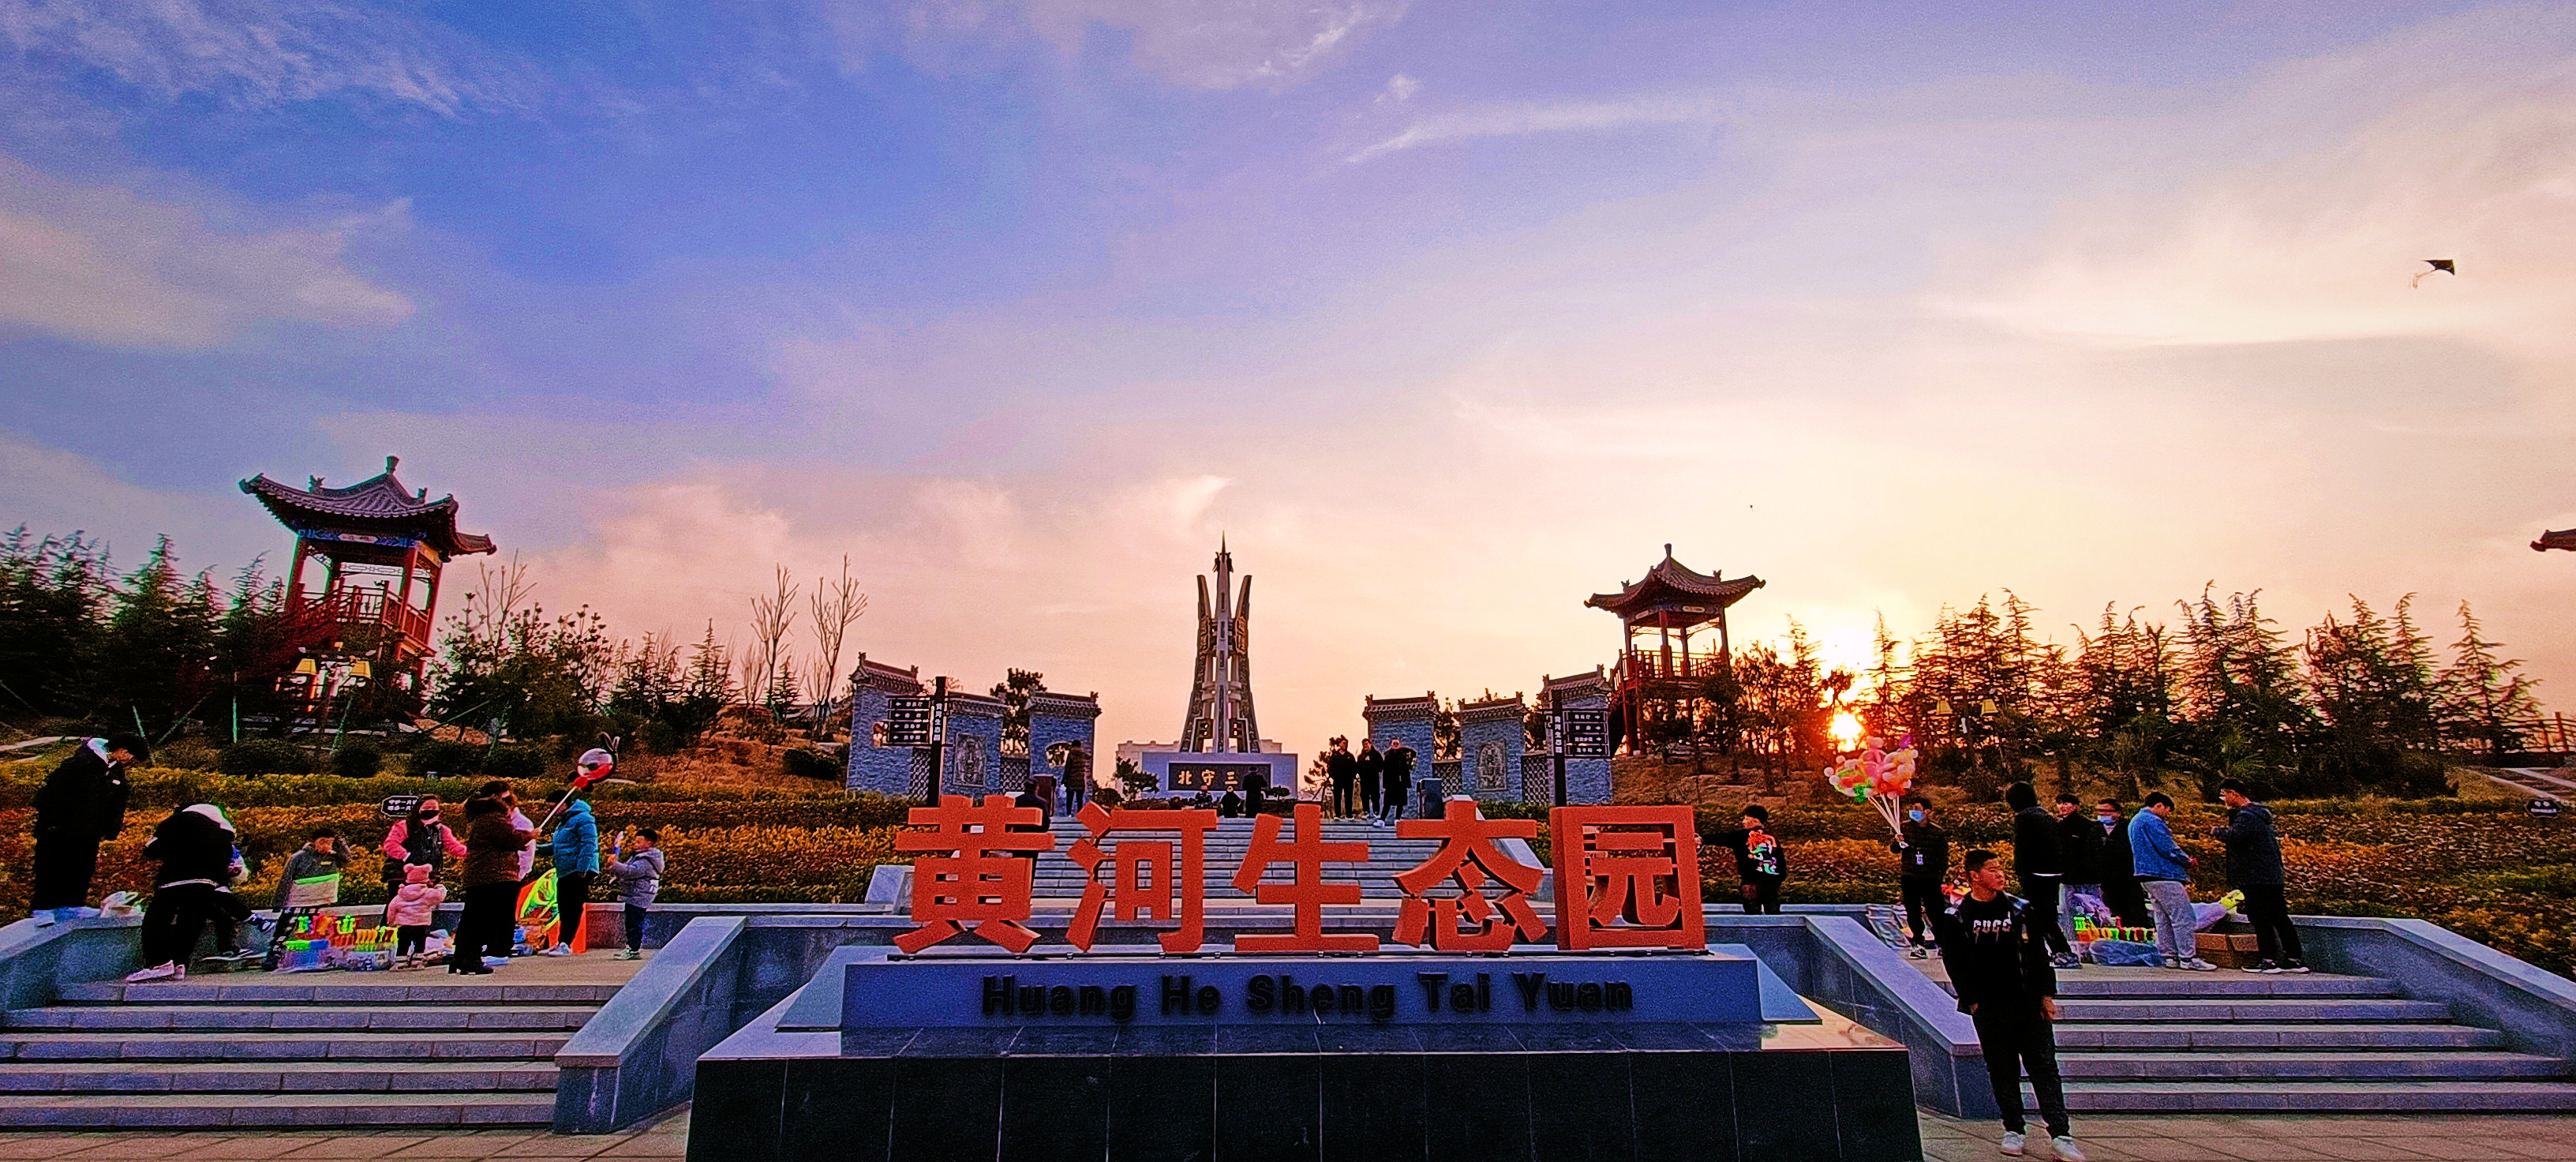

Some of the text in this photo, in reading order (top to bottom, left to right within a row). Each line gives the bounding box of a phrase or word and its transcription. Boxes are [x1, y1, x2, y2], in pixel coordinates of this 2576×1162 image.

[1178, 769, 1238, 786] 北守三
[893, 793, 1706, 954] 黄河生态园
[982, 972, 1634, 1021] Huang He Sheng Tai Yuan
